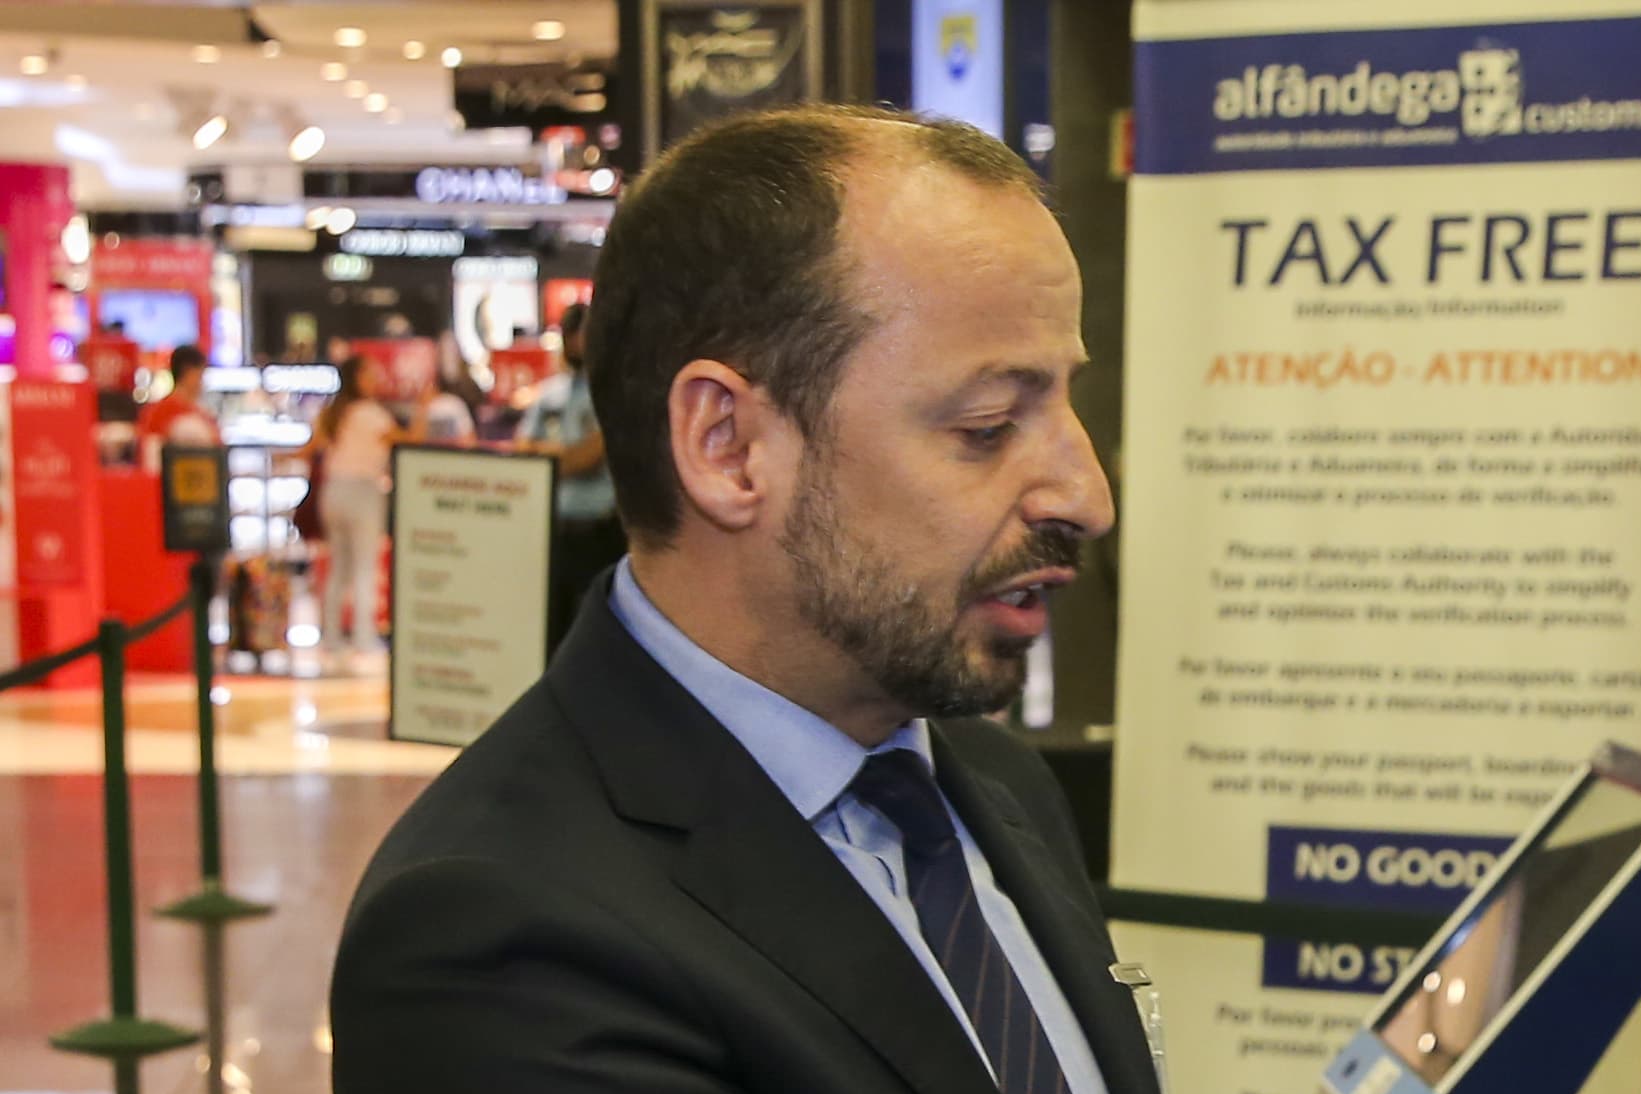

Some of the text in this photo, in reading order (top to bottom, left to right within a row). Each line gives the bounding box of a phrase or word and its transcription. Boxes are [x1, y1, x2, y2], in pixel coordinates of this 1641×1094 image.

[1213, 60, 1460, 125] alfândega
[1220, 217, 1396, 288] TAX
[1206, 344, 1396, 389] ATENÇÃO
[1295, 842, 1499, 890] NO GOOD
[1297, 942, 1416, 984] NO ST
